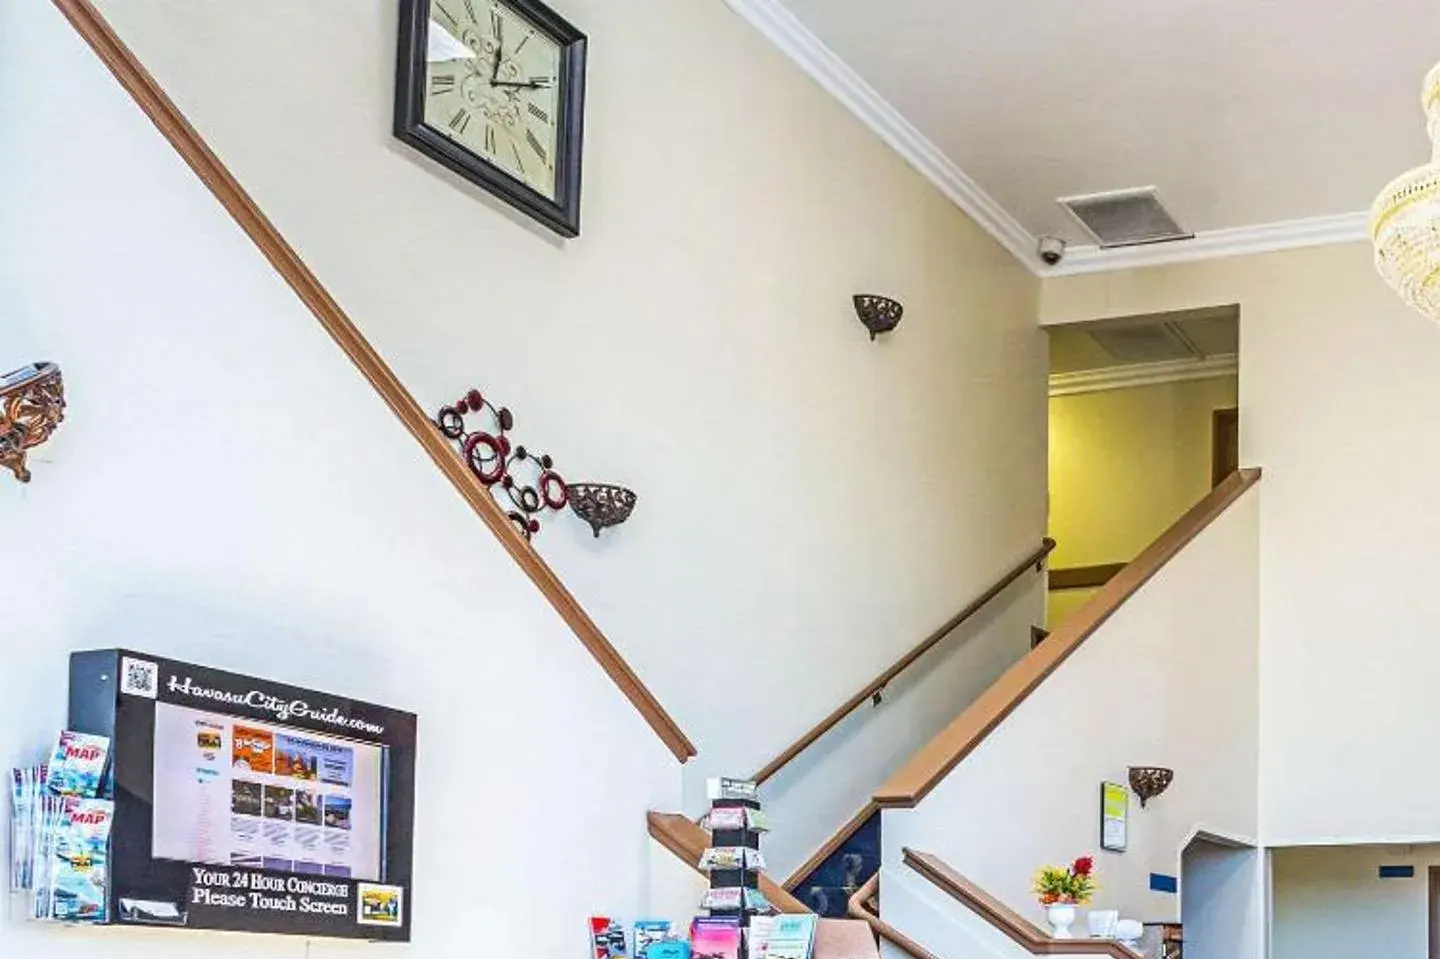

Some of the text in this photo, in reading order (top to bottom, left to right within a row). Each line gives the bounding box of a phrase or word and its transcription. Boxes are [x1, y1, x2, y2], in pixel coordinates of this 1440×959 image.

[65, 747, 101, 762] MAP
[71, 812, 105, 825] MAP
[192, 867, 349, 898] YOUR 24 HOUR CONCIERGE
[191, 887, 348, 915] Please Touch Screen
